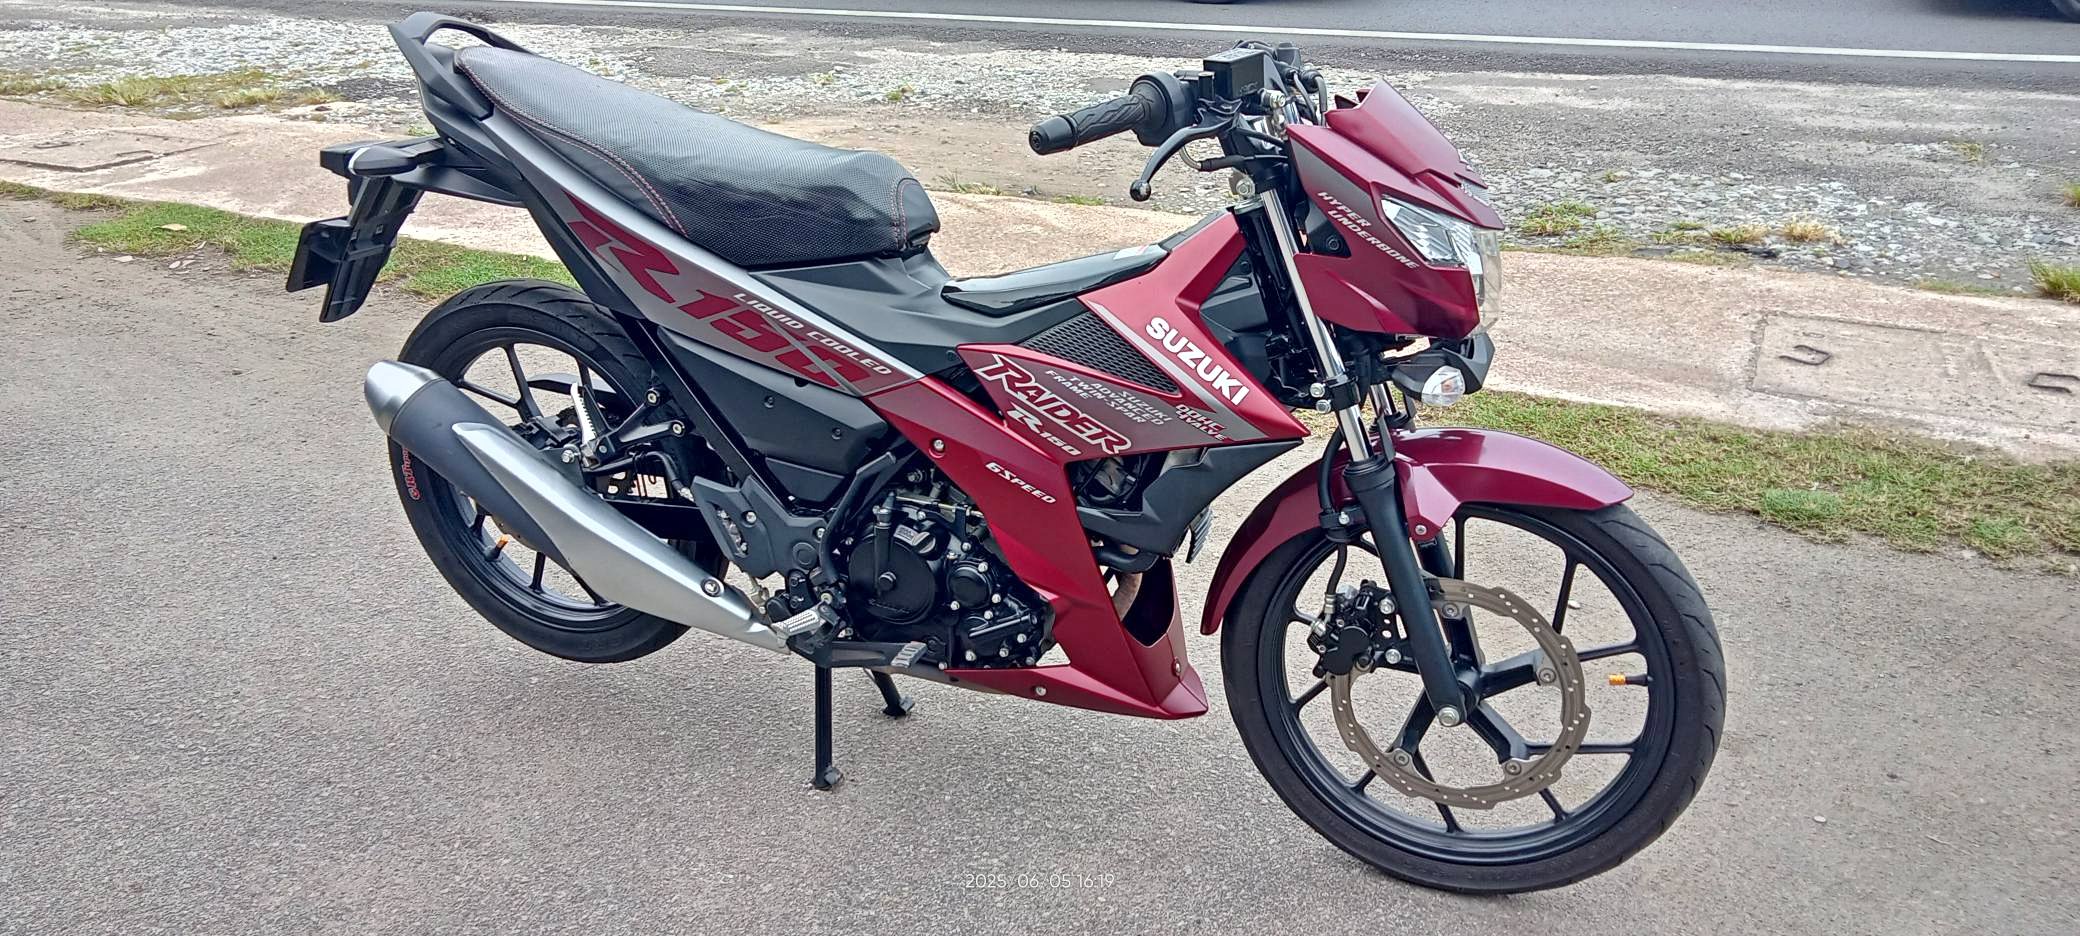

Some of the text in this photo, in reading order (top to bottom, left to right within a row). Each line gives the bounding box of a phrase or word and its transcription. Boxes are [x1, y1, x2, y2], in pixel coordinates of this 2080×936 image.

[1317, 191, 1371, 228] HYPER
[1327, 210, 1420, 269] UNDERBONE
[734, 292, 893, 375] LIQUID COOLED
[1045, 370, 1093, 399] FRAME
[1145, 316, 1250, 406] SUZUKI
[973, 353, 1132, 455] RAIDER
[1070, 375, 1147, 424] TWIN-SPAR
[1090, 383, 1165, 426] ADVANCED
[1118, 390, 1173, 422] SUZUKI
